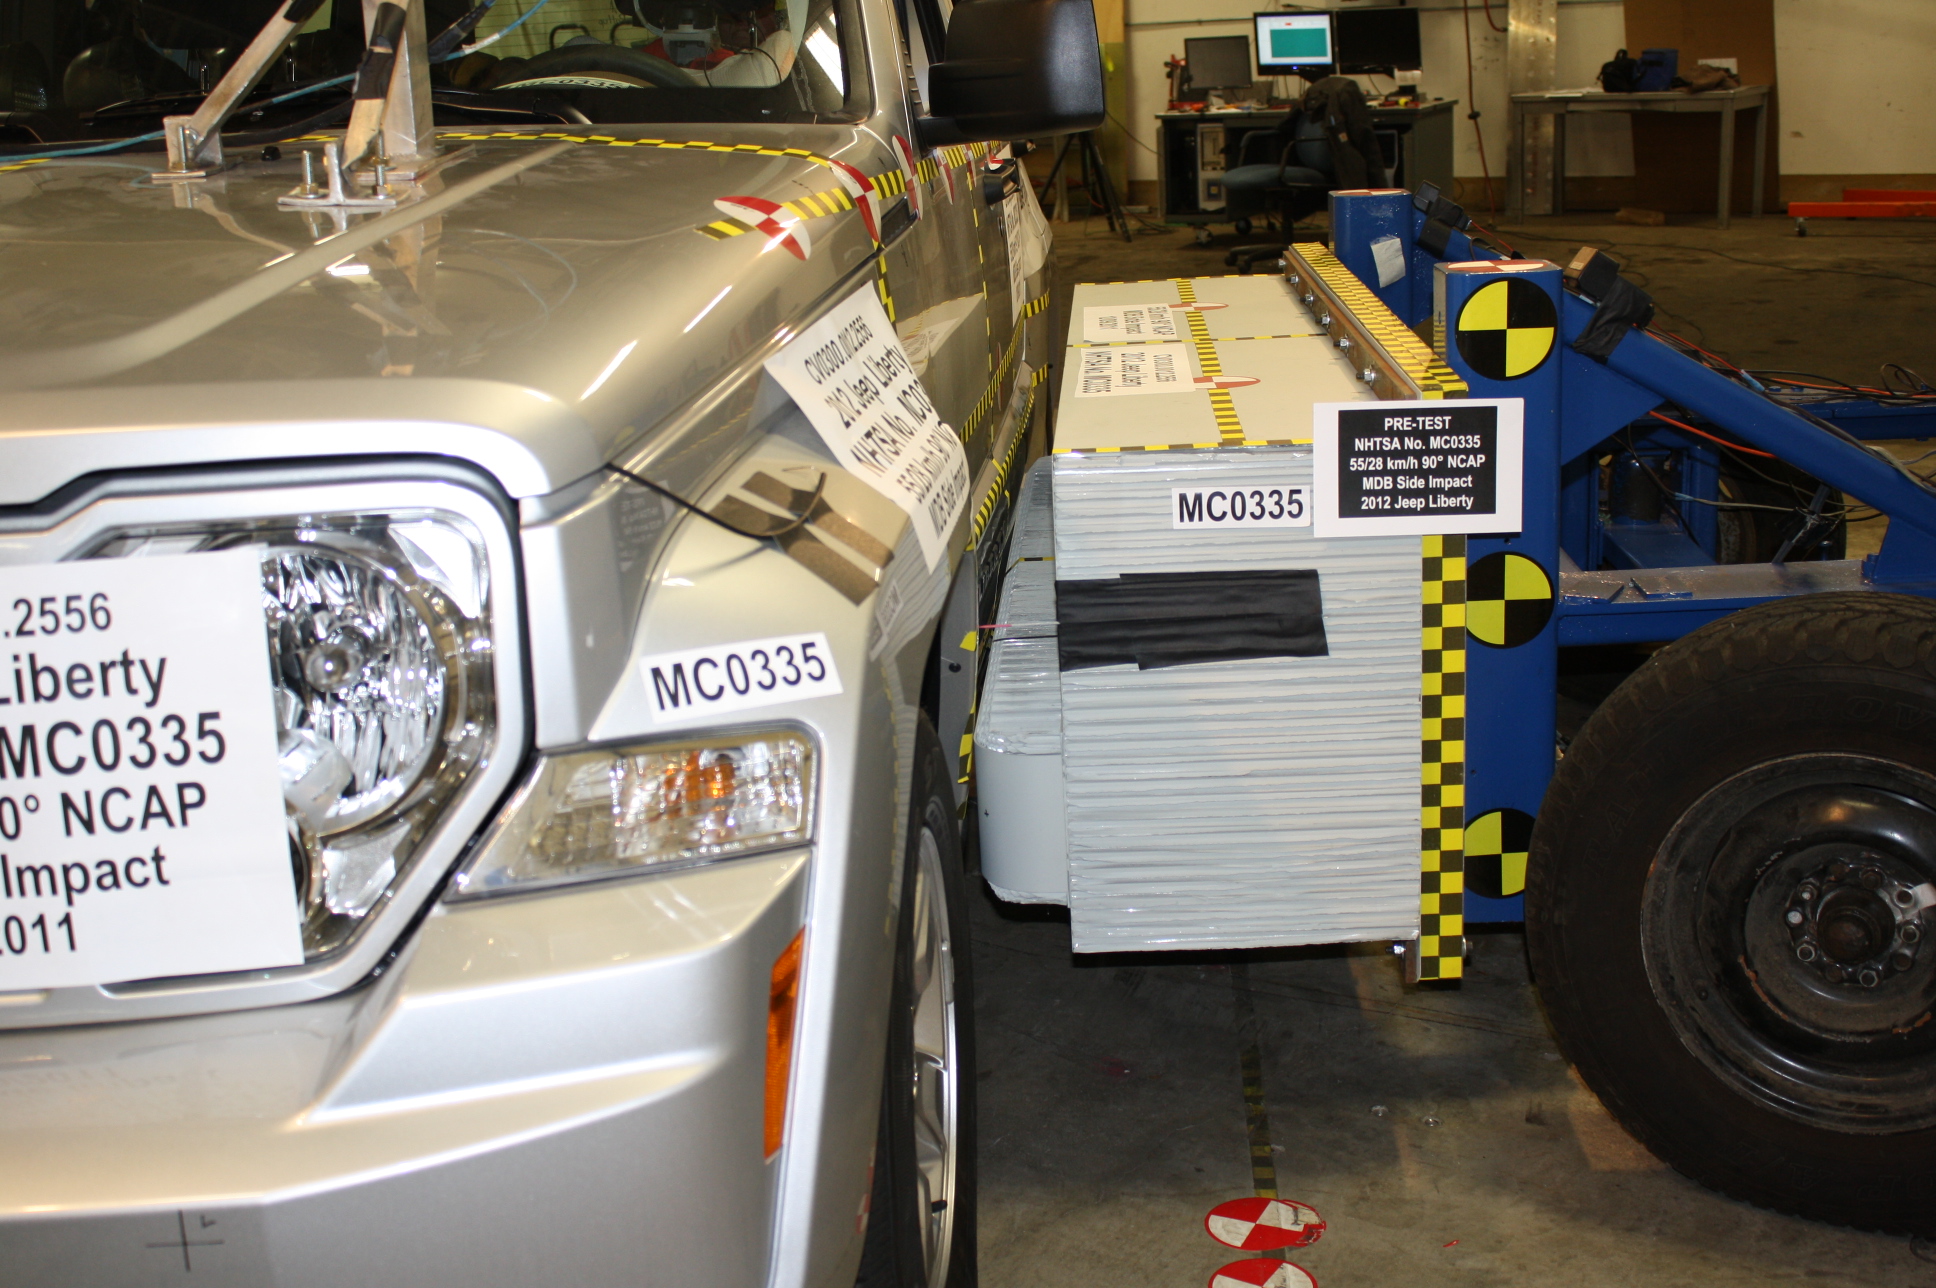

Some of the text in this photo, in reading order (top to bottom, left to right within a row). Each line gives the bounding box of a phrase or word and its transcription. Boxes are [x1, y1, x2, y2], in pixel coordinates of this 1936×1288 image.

[862, 344, 913, 388] Liberty
[842, 374, 885, 409] Jeep
[850, 421, 907, 478] NHTSA
[881, 411, 918, 444] No.
[1354, 435, 1481, 451] NHTSA No. MC0335
[1384, 416, 1452, 431] PRE-TEST
[1349, 454, 1486, 471] 55/28 km/h 90° NCAP
[1362, 474, 1473, 491] MDB Side Impact
[1177, 488, 1305, 523] MC0335
[1361, 494, 1474, 511] 2012 Jeep Liberty
[3, 592, 112, 638] .2556
[650, 641, 826, 711] MC0335
[0, 711, 227, 780] MC0335
[60, 781, 208, 838] NCAP
[1, 845, 170, 907] Impact
[0, 912, 77, 956] 011
